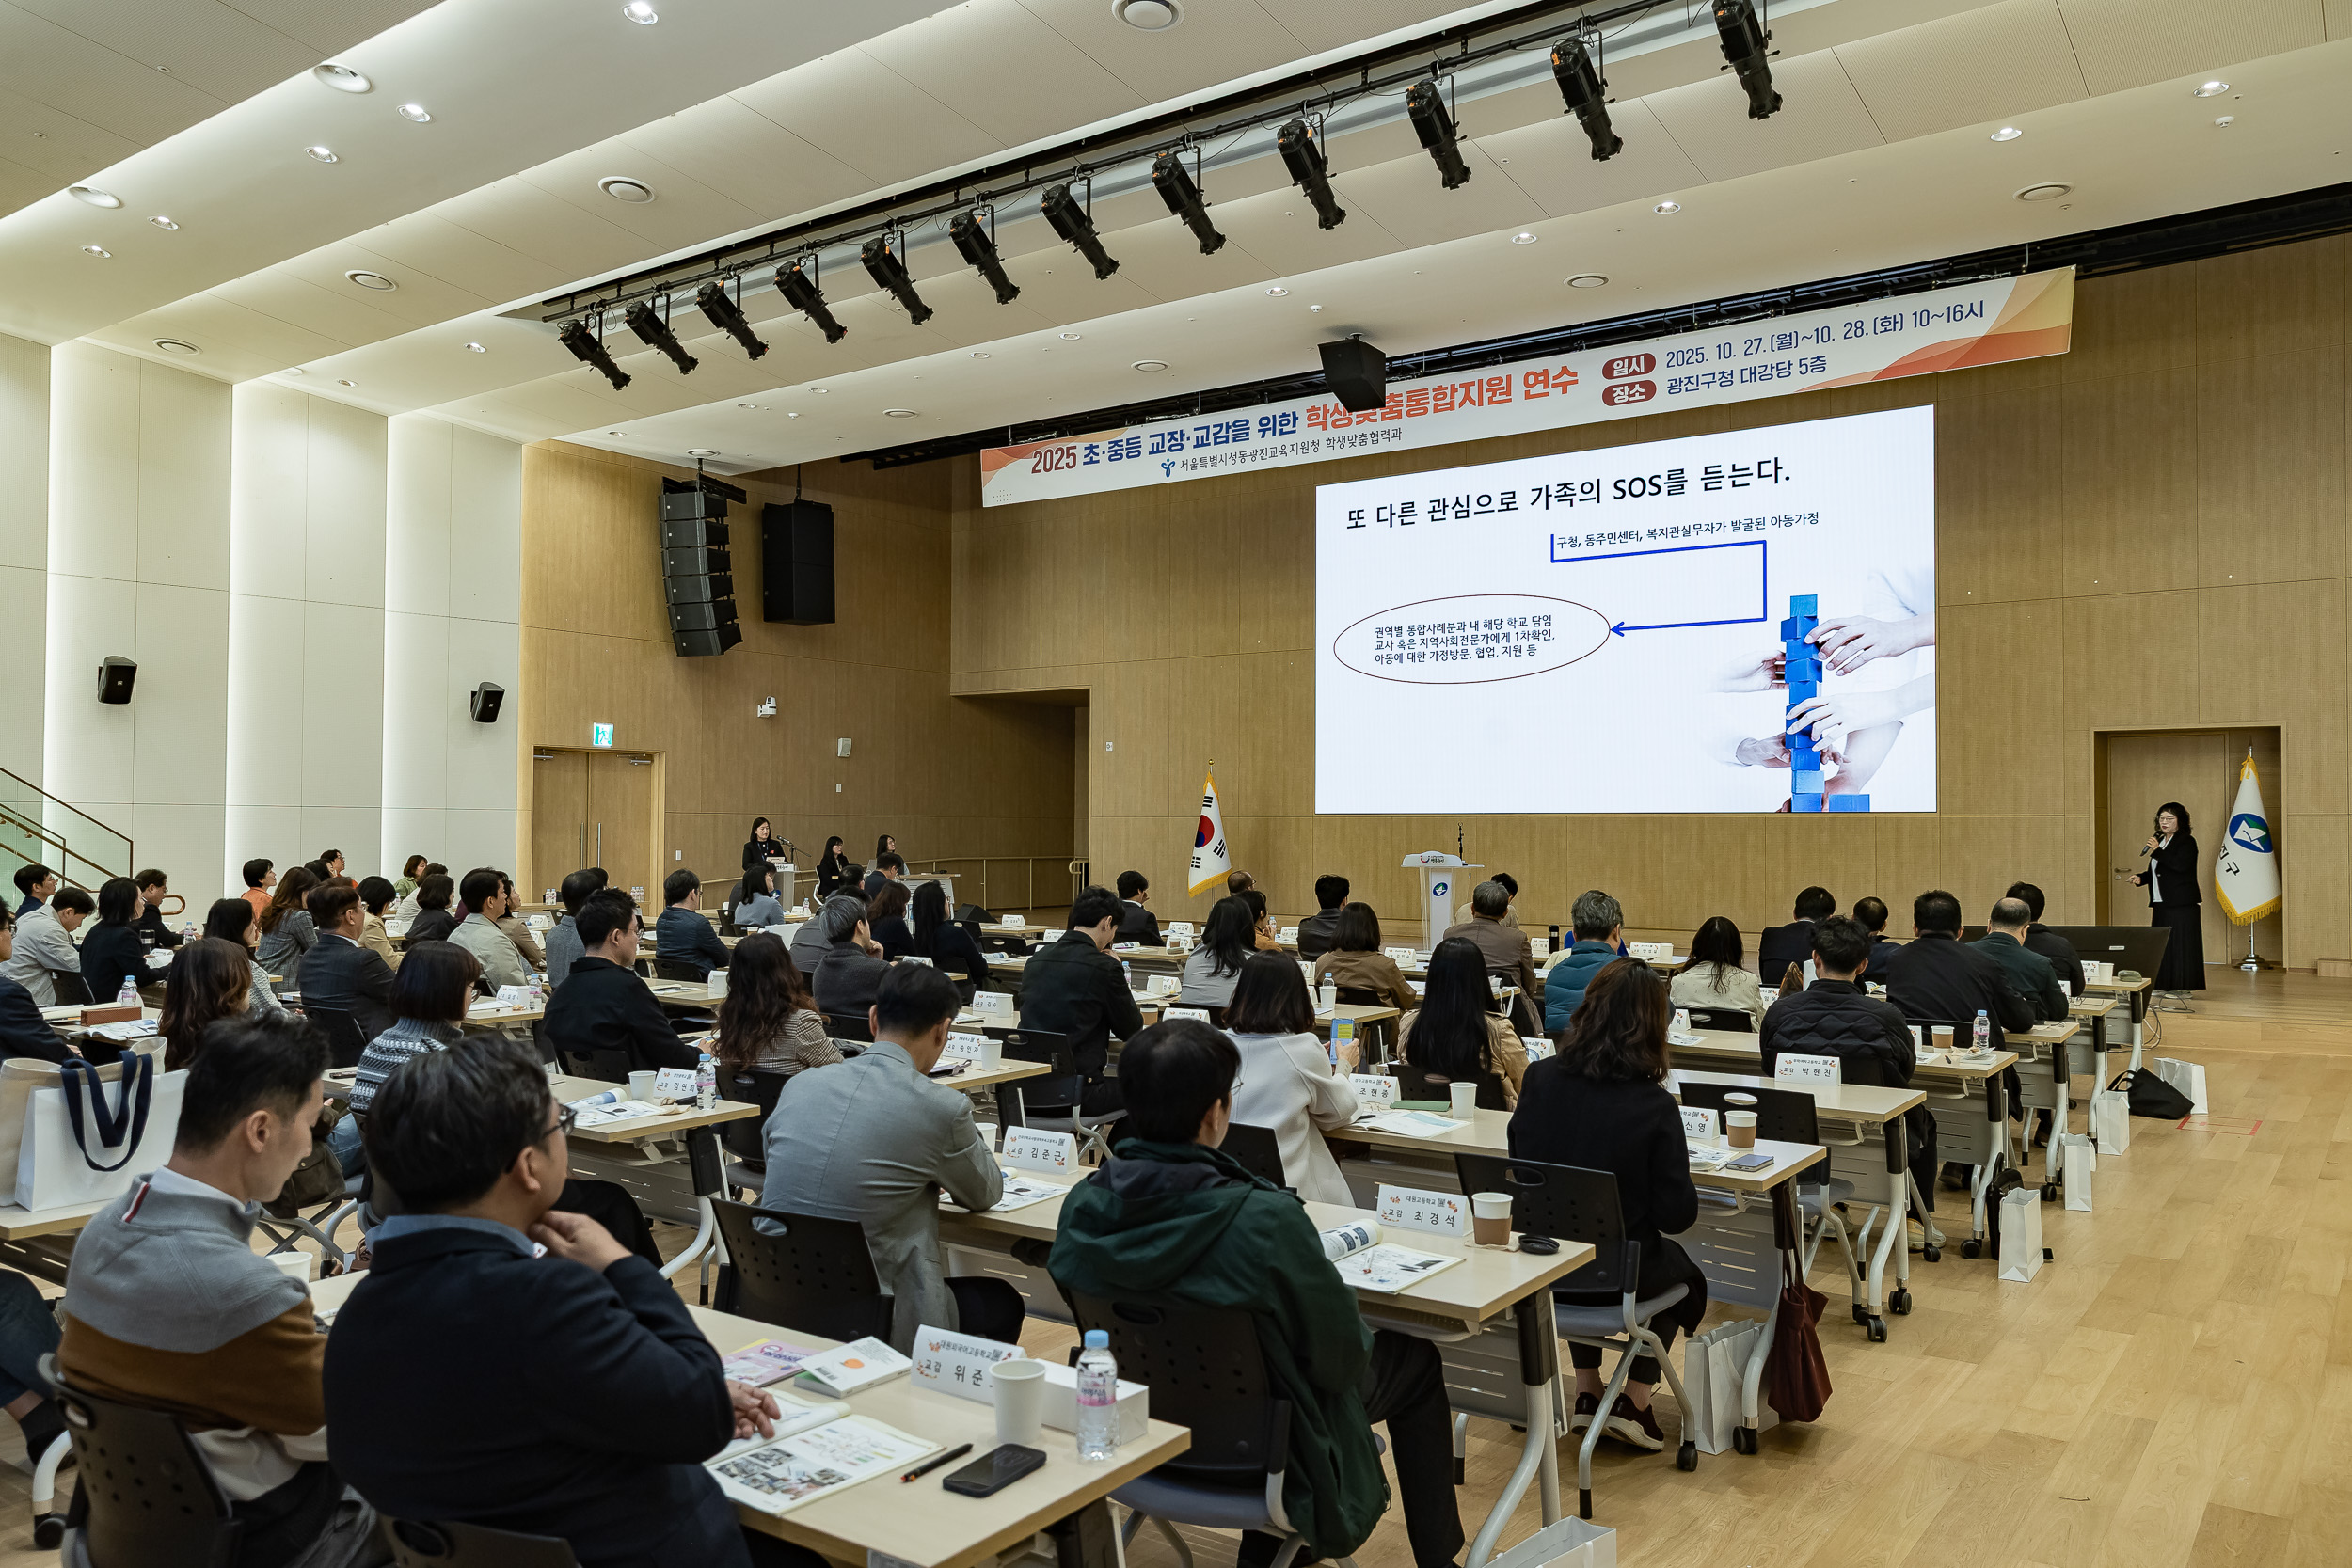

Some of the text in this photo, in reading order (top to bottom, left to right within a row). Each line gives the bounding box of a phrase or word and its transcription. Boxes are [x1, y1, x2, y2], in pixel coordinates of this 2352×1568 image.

[1666, 345, 1709, 369] 2025.
[1715, 341, 1738, 360] 10.
[1911, 299, 1984, 329] 10~16시
[1613, 355, 1645, 377] 일시
[1666, 355, 1828, 395] 광진구청 대강당 5층
[1613, 382, 1645, 404] 장소
[1031, 445, 1077, 475] 2025
[1082, 436, 1142, 467] 초·중등
[1147, 418, 1251, 455] 교장·교감을
[1257, 411, 1298, 439] 위한
[1522, 365, 1580, 401] 연수
[1179, 427, 1403, 472] 서울특별시성동광진교육지원청 학생맞춤협력과
[1346, 456, 1791, 530] 또 다른 관심으로 가족의 SOS를 듣는다.
[1556, 511, 1820, 549] 구청, 동주민센터, 복지관실무자가 발굴된 아동가정
[1375, 614, 1552, 639] 권역별 통합사례분과 내 해당 학교 담임
[1375, 628, 1556, 652] 교사 혹은 지역사회전문가에게 1차확인,
[1375, 643, 1538, 665] 아동에 대한 가정방문, 협업, 지원 등
[1388, 1208, 1403, 1218] 교감
